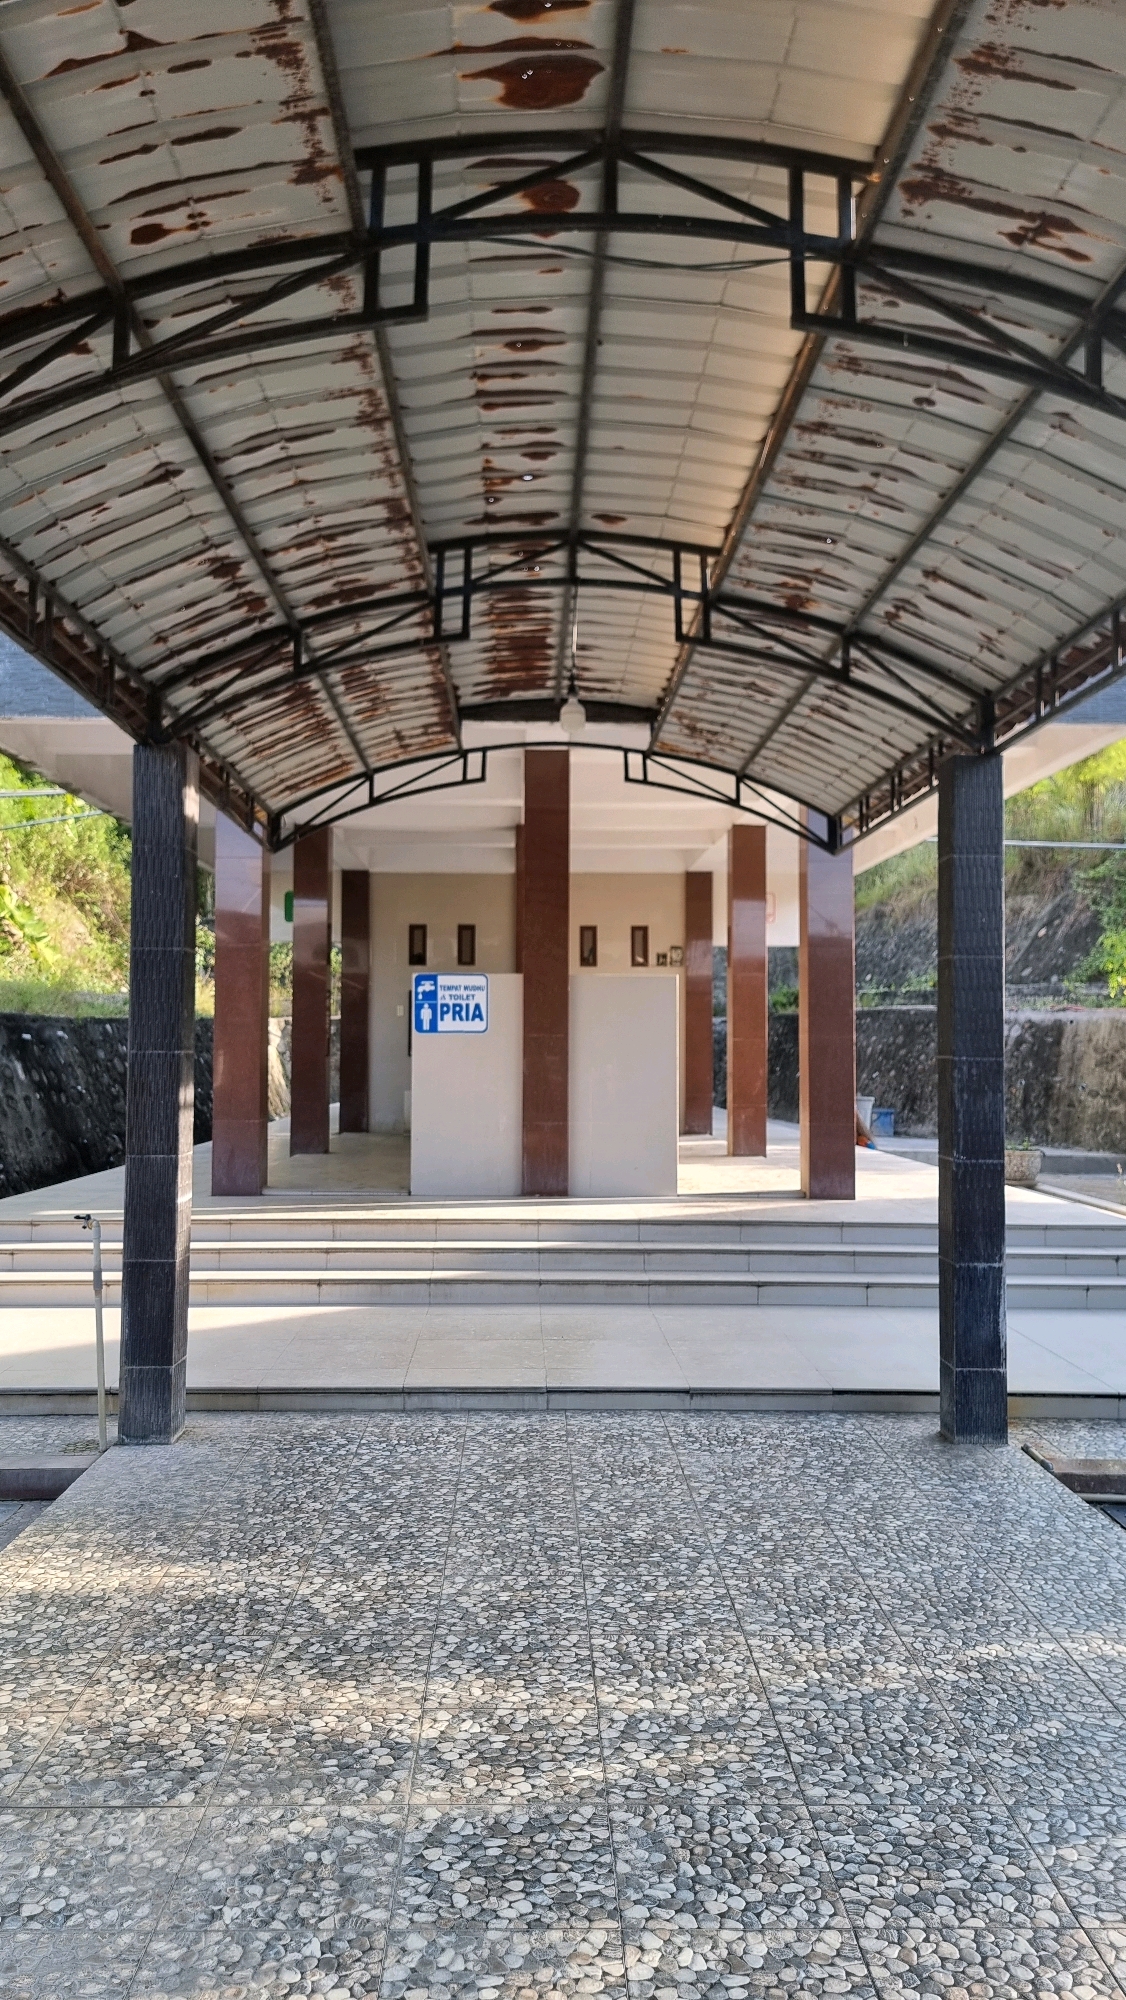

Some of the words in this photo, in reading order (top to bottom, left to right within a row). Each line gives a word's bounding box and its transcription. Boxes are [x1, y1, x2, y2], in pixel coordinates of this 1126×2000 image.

[440, 984, 462, 992] TEMPAT
[463, 984, 485, 992] WUDHU
[449, 993, 476, 1001] TOILET
[440, 1003, 484, 1021] PRIA
